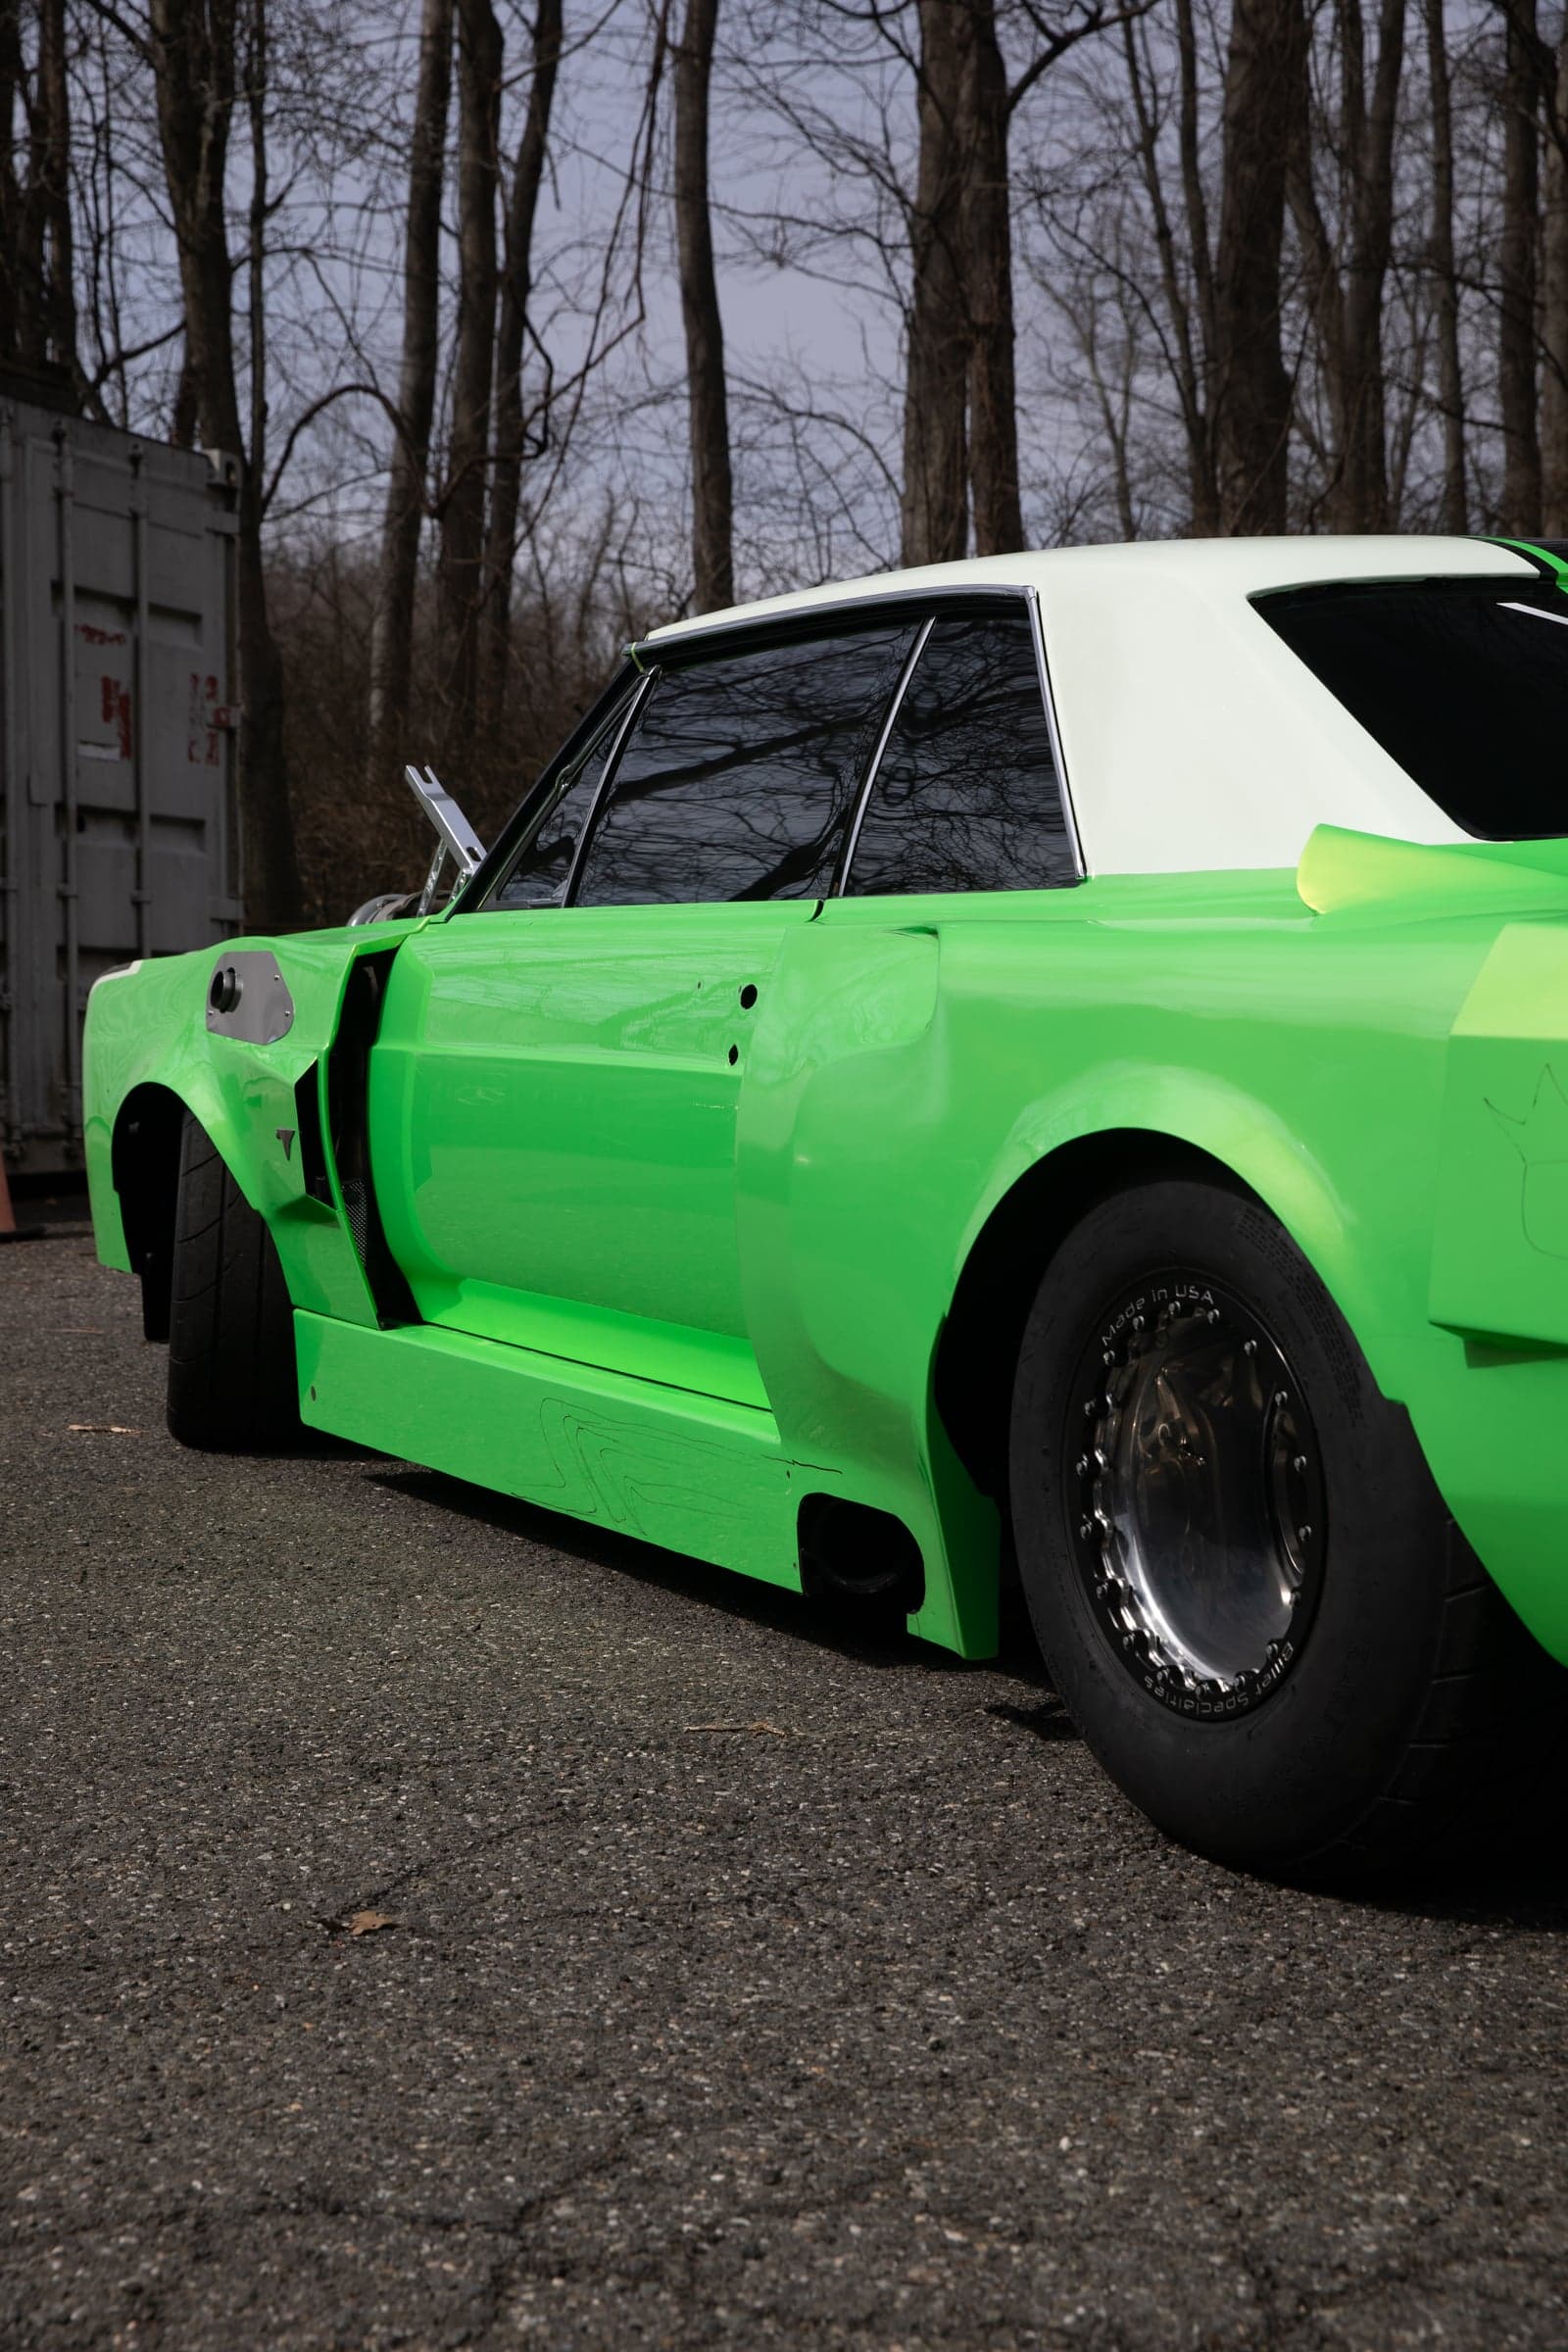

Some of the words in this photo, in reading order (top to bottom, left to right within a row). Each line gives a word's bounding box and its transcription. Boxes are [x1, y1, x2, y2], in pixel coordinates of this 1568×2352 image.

[1102, 1298, 1146, 1346] Made
[1152, 1287, 1168, 1302] in
[1175, 1284, 1215, 1304] USA
[1255, 1642, 1294, 1694] Billet
[1145, 1676, 1249, 1714] Specialties
